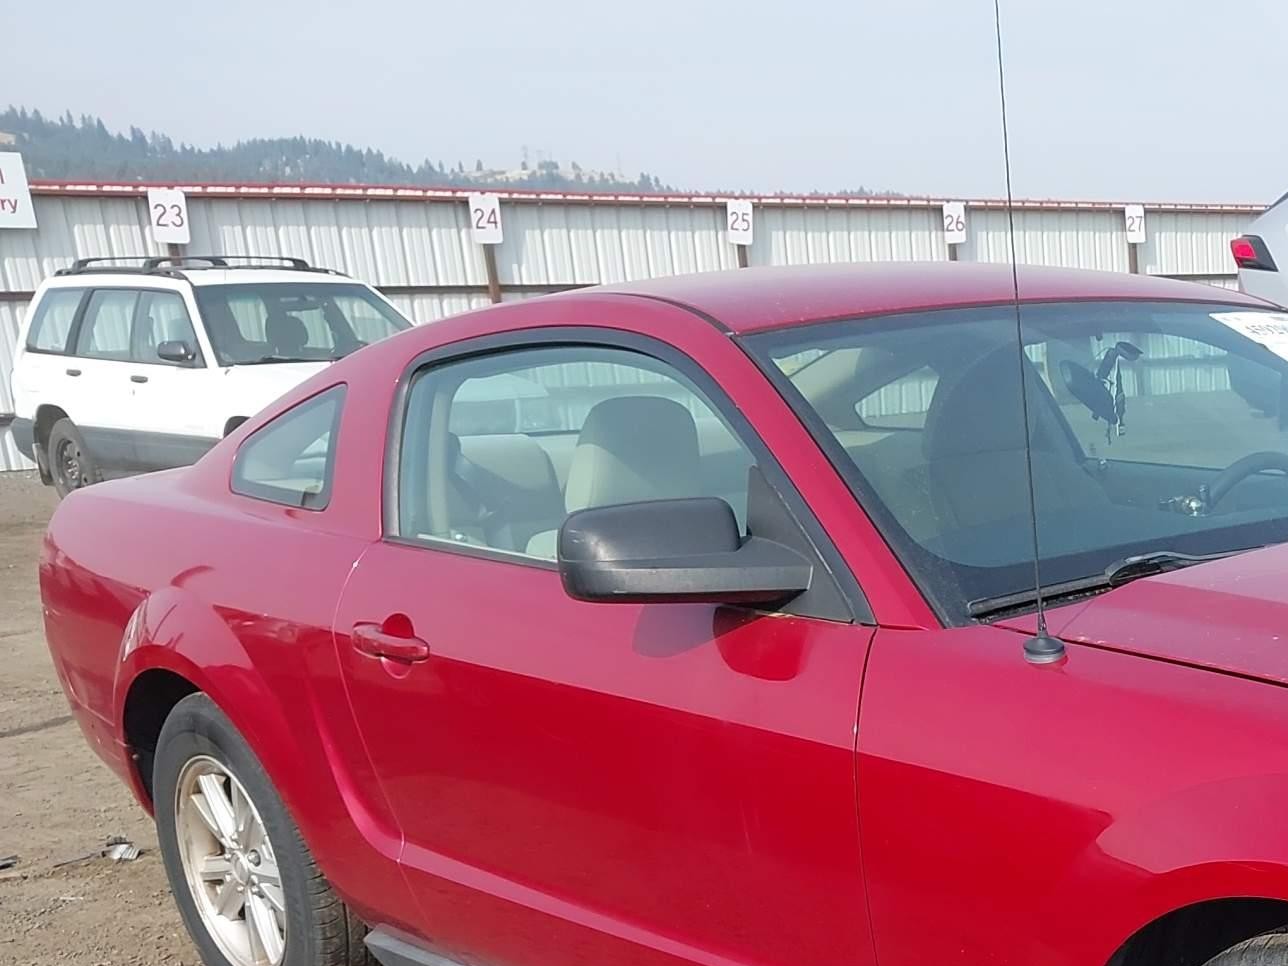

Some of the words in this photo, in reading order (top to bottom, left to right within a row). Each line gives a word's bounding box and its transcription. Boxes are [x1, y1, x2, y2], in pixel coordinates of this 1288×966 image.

[153, 203, 184, 228] 23
[473, 207, 498, 230] 24
[730, 211, 751, 232] 25
[944, 214, 965, 232] 26
[1127, 215, 1143, 232] 27
